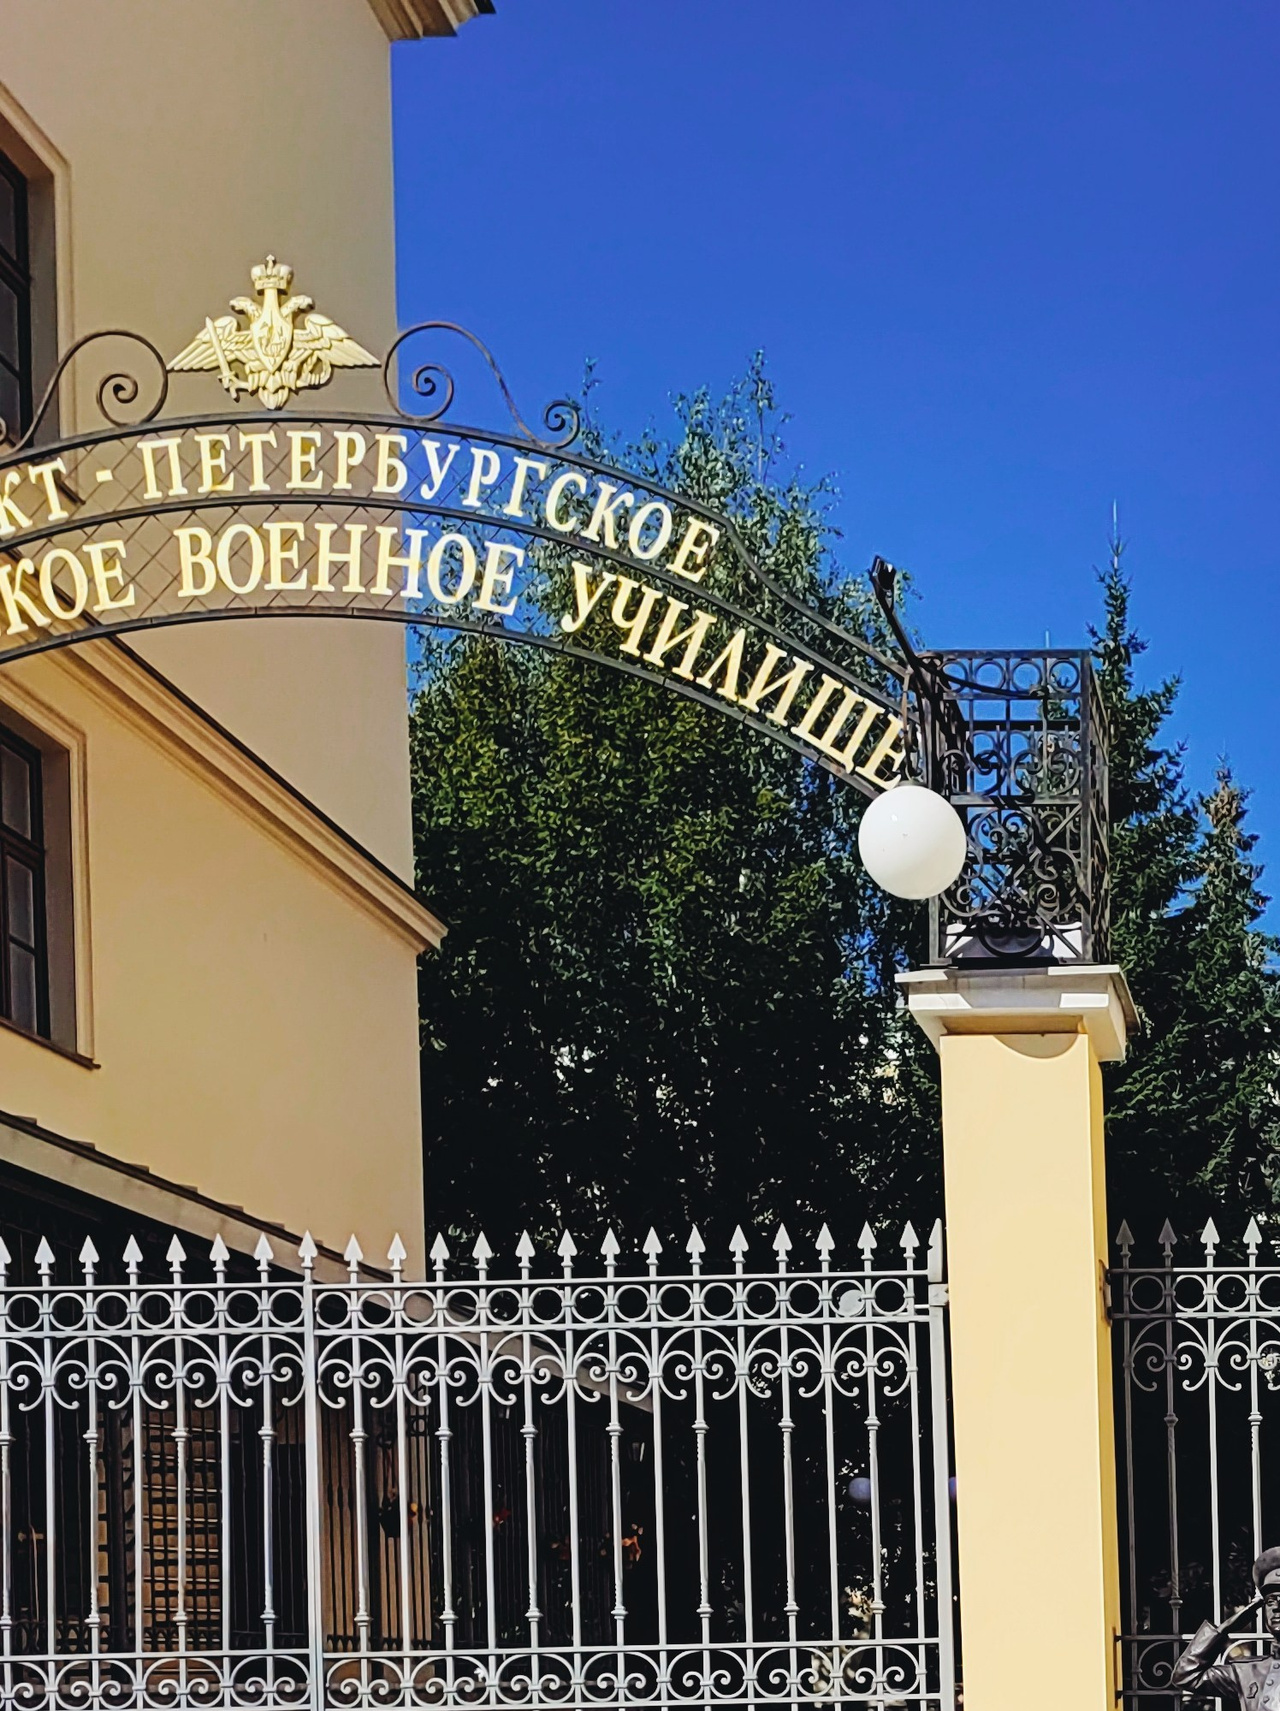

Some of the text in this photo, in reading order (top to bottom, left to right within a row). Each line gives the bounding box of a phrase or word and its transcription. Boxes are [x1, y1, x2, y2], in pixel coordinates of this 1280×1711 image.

[137, 428, 719, 583] ПЕТЕРБУРГСКОЕ
[173, 521, 525, 616] ВОЕННОЕ
[561, 564, 906, 790] УЧИЛИЩЕ
